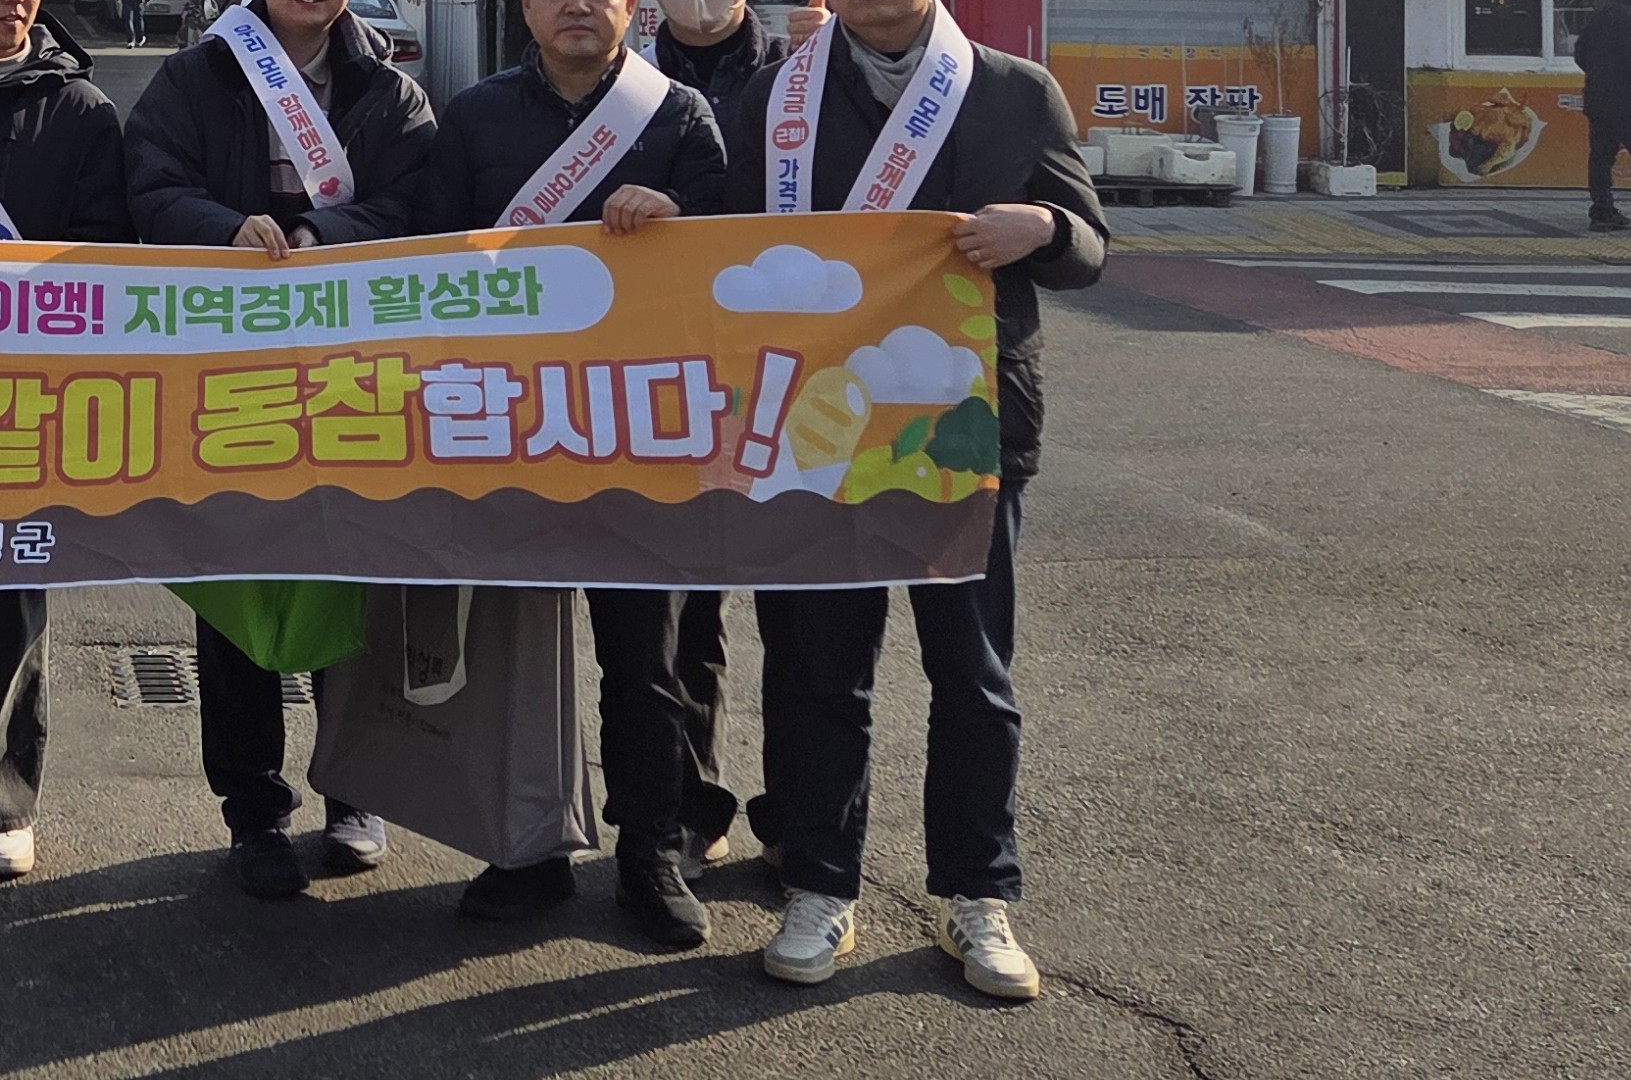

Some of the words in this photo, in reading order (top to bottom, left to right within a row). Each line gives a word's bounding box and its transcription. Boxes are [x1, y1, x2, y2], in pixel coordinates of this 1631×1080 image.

[233, 23, 268, 54] 우리
[255, 55, 289, 90] 모두
[276, 92, 332, 171] 함께해요
[929, 51, 959, 98] 우리
[1091, 84, 1168, 124] 도배
[904, 95, 942, 140] 모두
[532, 124, 618, 214] 바가지요금
[123, 278, 350, 337] 지역경제
[367, 264, 544, 325] 활성화
[197, 348, 801, 477] 동참합시다!
